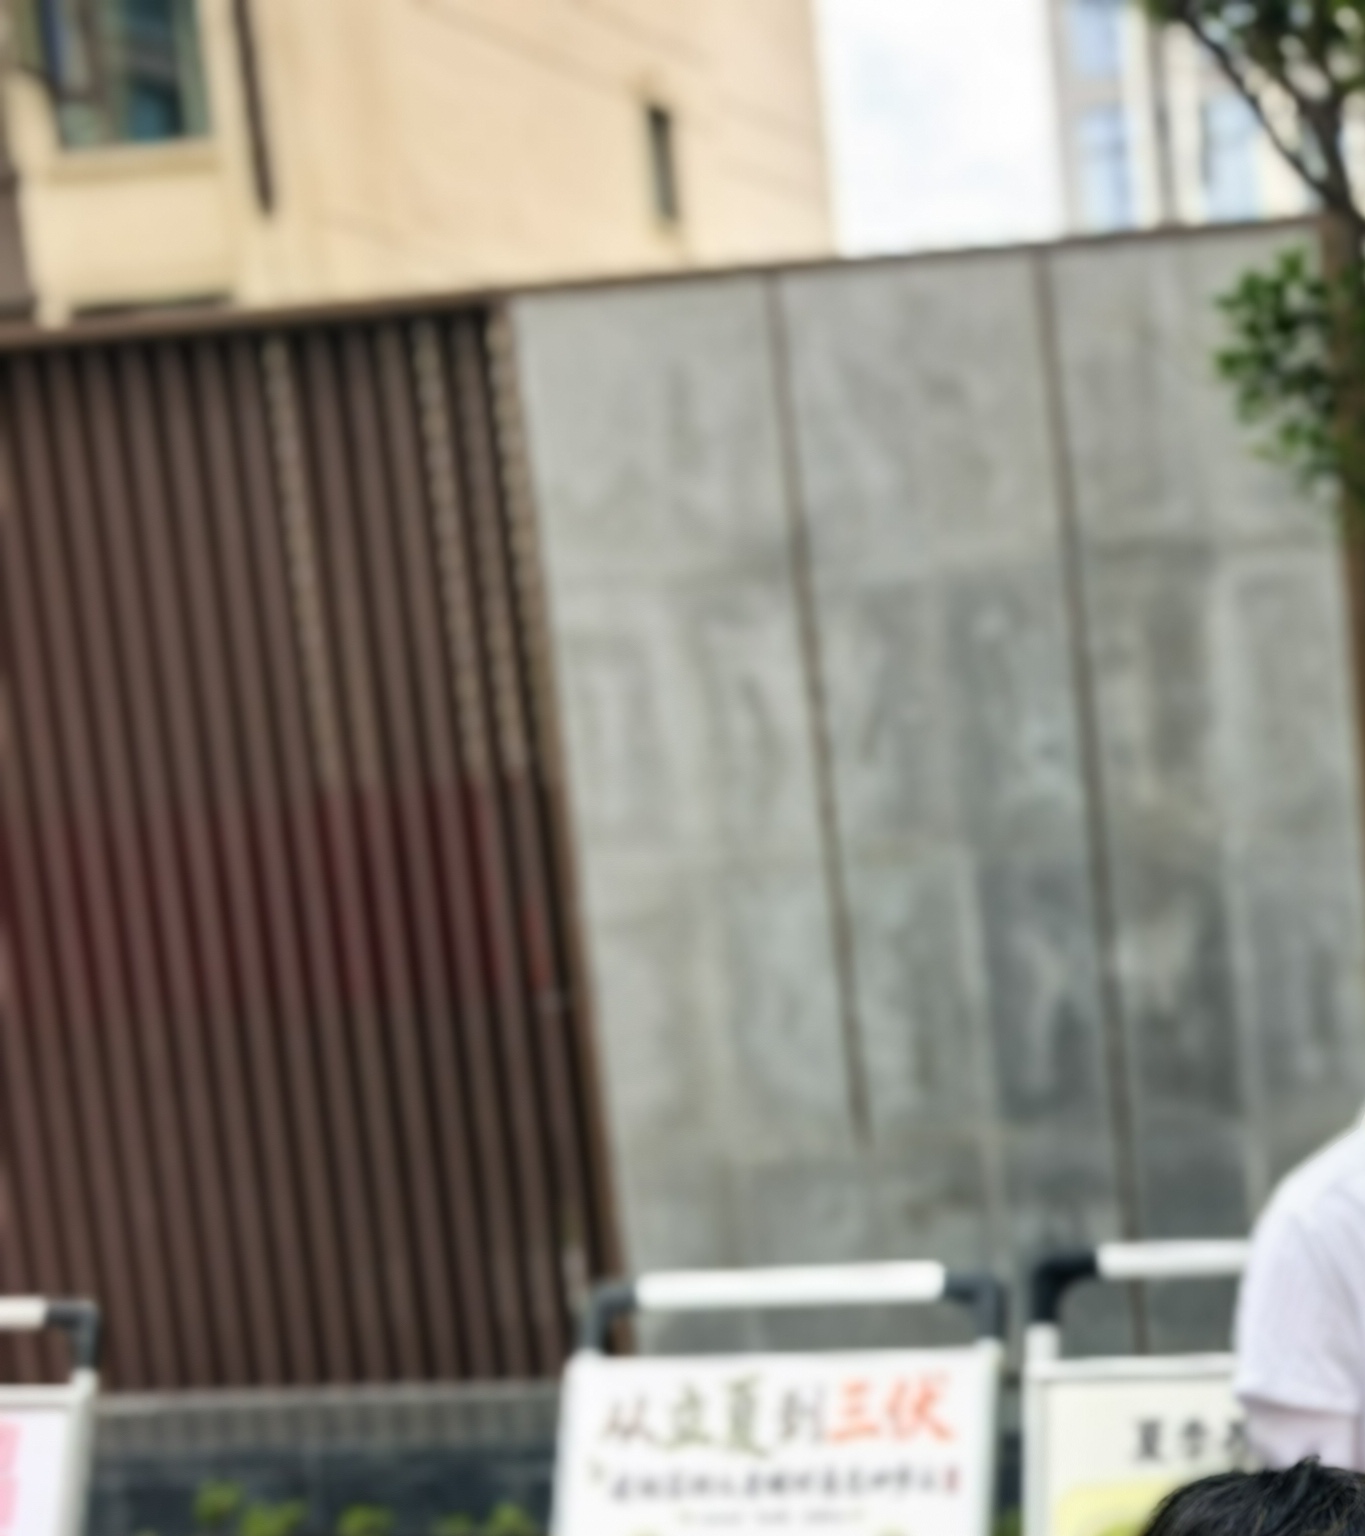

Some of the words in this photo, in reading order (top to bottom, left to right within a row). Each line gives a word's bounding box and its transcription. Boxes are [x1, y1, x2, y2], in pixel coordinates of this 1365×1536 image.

[602, 1373, 956, 1458] 从立夏到三伏
